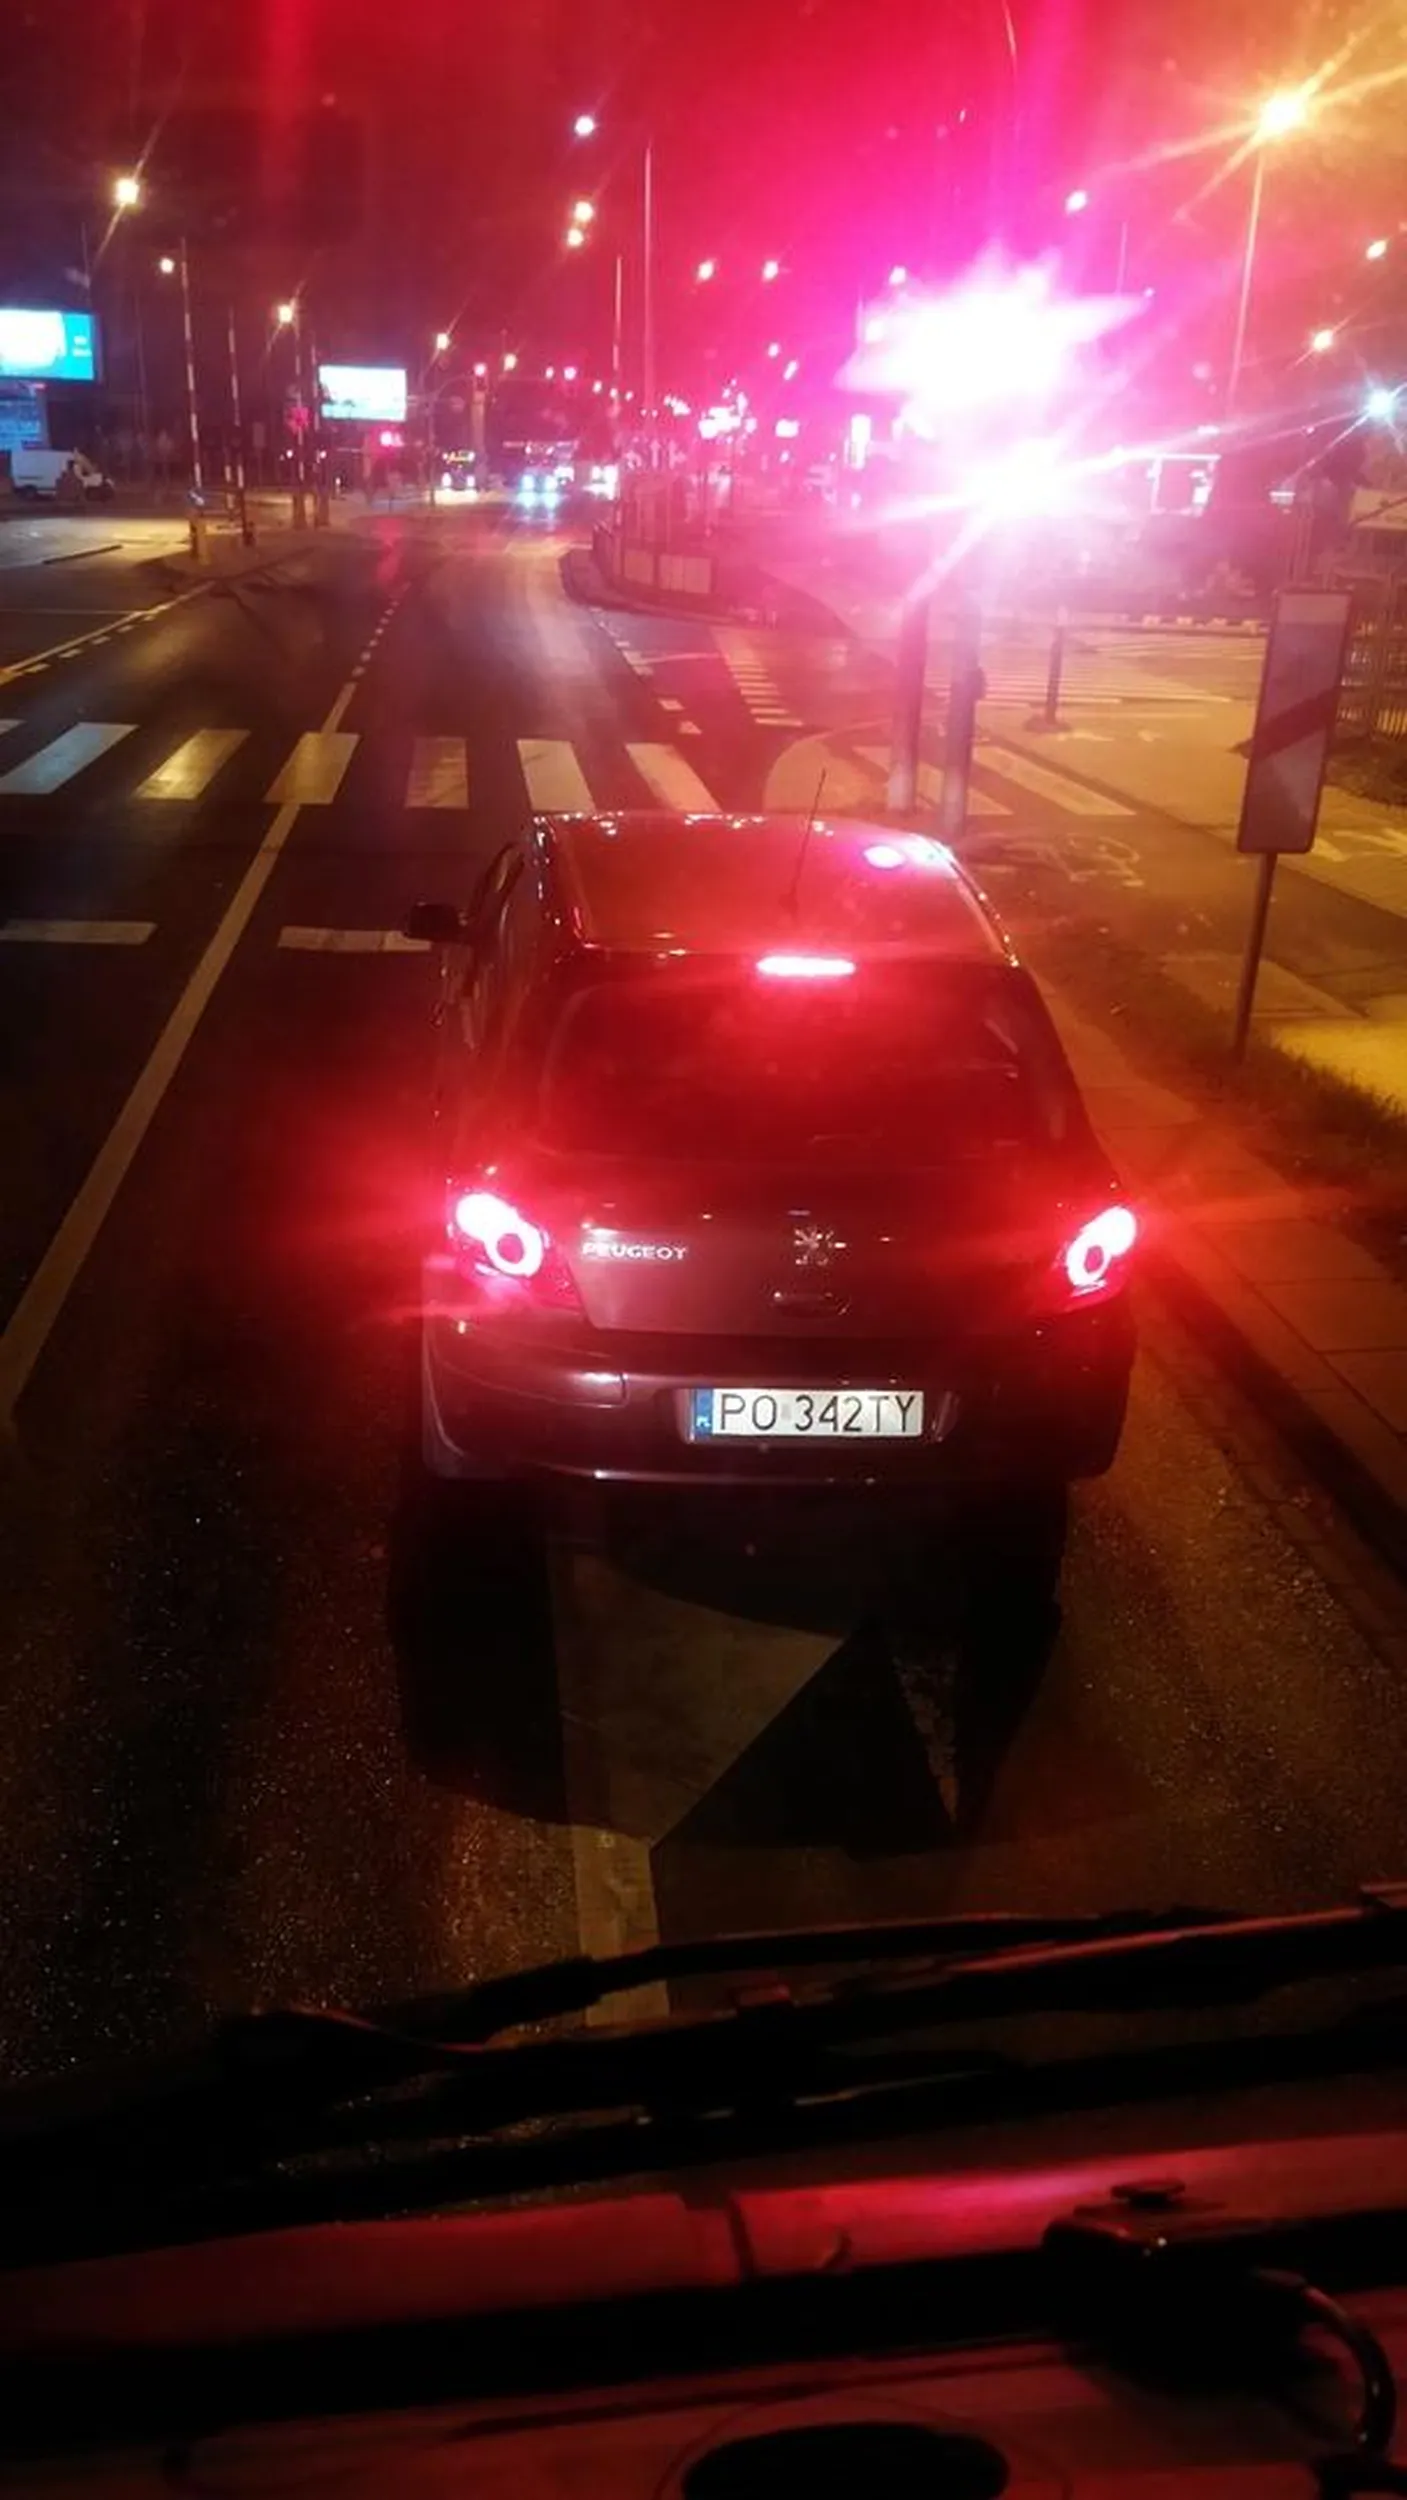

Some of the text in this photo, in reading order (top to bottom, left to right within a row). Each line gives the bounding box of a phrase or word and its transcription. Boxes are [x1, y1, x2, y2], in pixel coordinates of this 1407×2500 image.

[582, 1243, 688, 1260] PEUGEOT
[720, 1393, 916, 1432] PO 342TY
